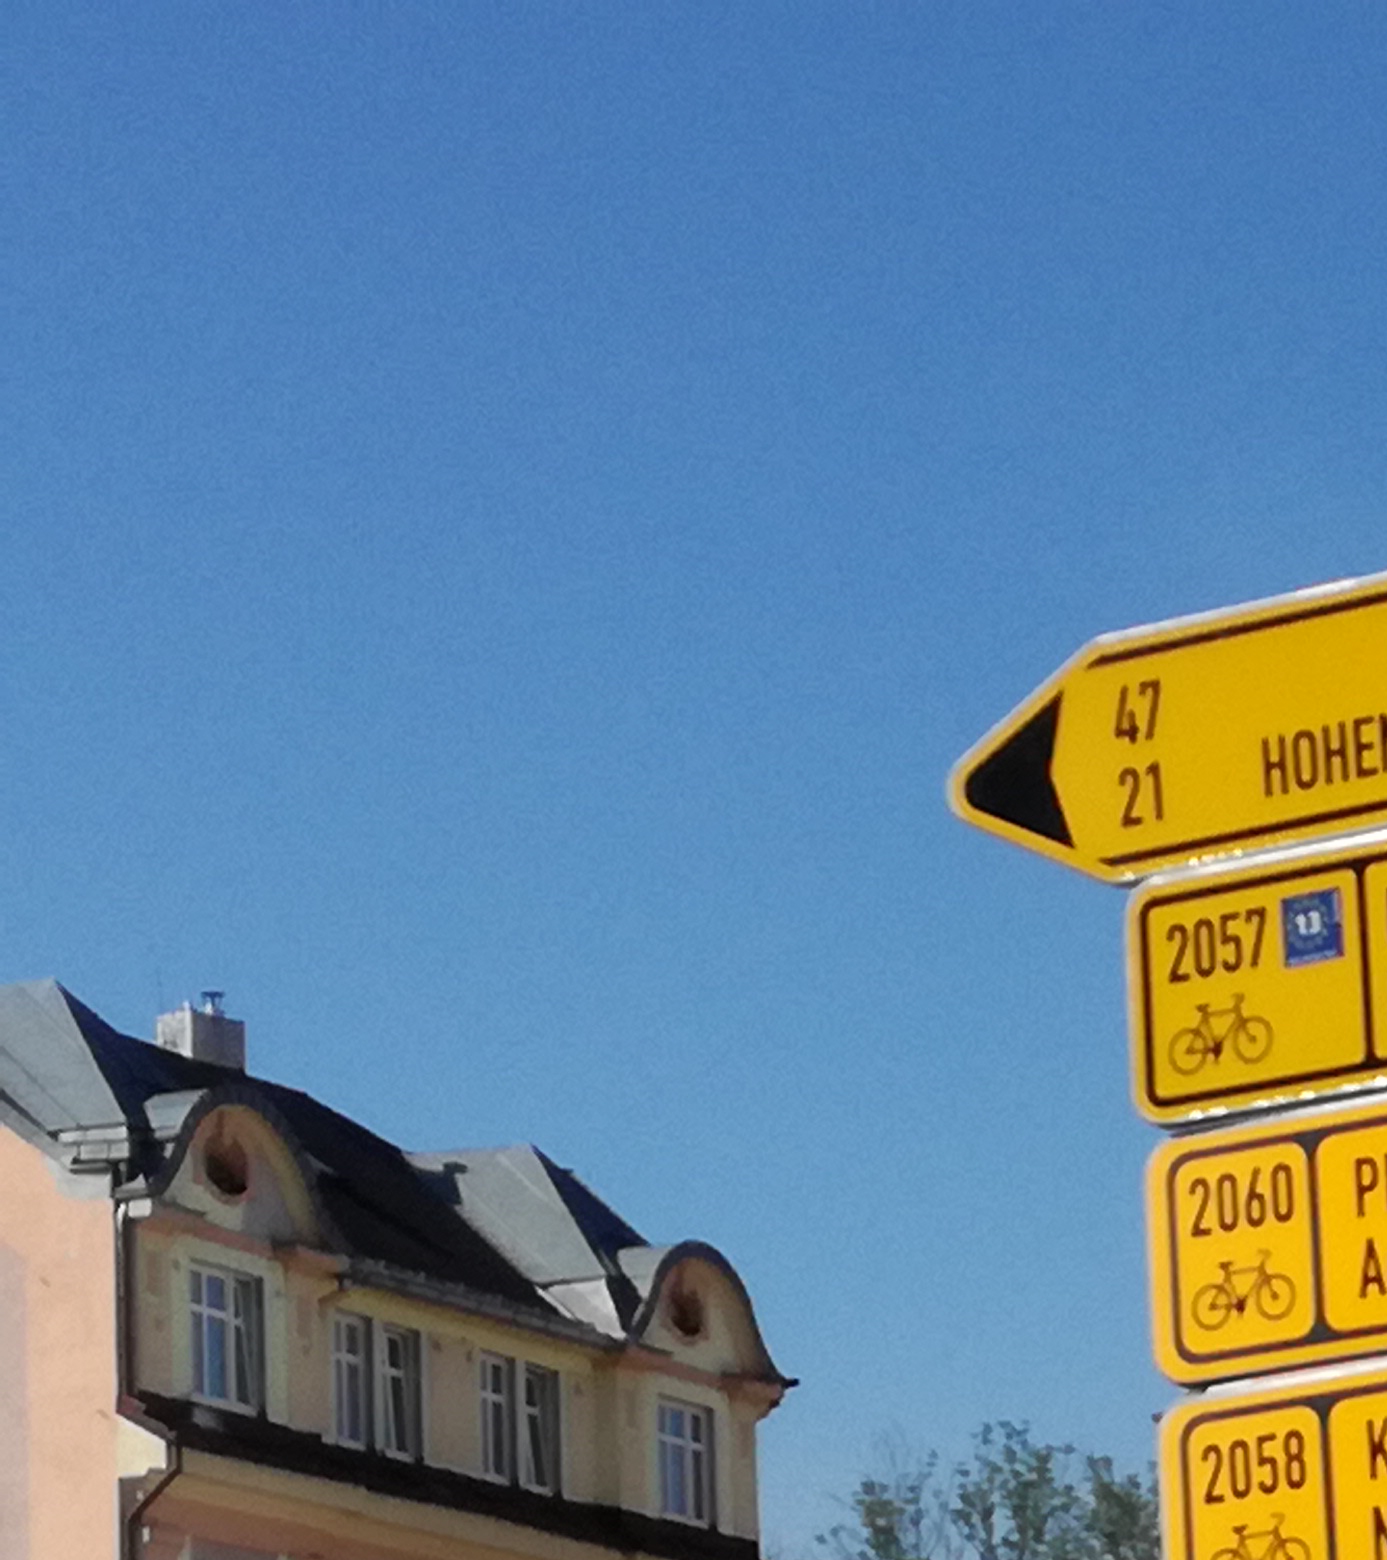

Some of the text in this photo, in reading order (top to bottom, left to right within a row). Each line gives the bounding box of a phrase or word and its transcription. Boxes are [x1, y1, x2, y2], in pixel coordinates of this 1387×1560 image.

[1114, 680, 1161, 743] 47
[1118, 763, 1164, 828] 21
[1166, 906, 1267, 984] 2057
[1189, 1163, 1294, 1237] 2060
[1201, 1430, 1307, 1505] 2058
